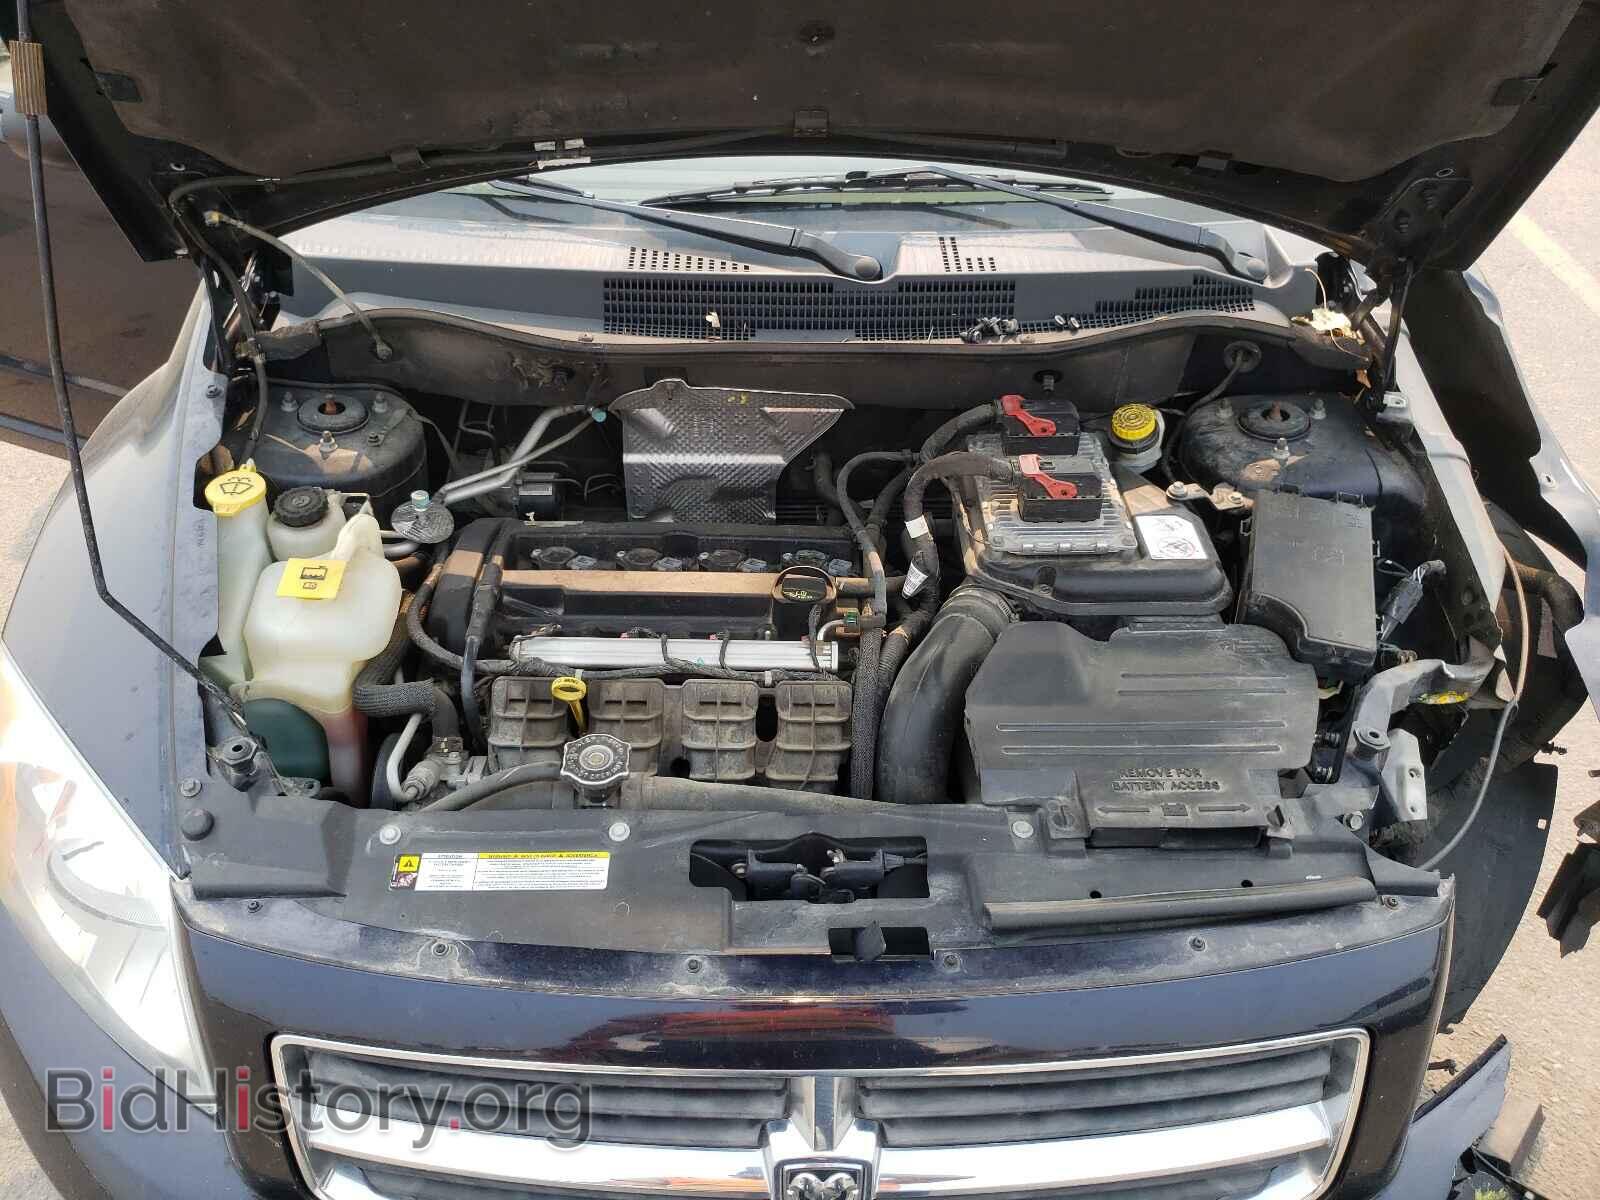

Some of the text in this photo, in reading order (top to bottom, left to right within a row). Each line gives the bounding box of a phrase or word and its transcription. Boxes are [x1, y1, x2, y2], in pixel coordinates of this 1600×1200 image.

[1119, 767, 1203, 778] REMOVE FOR
[1112, 780, 1221, 792] BATTERY ACCESS
